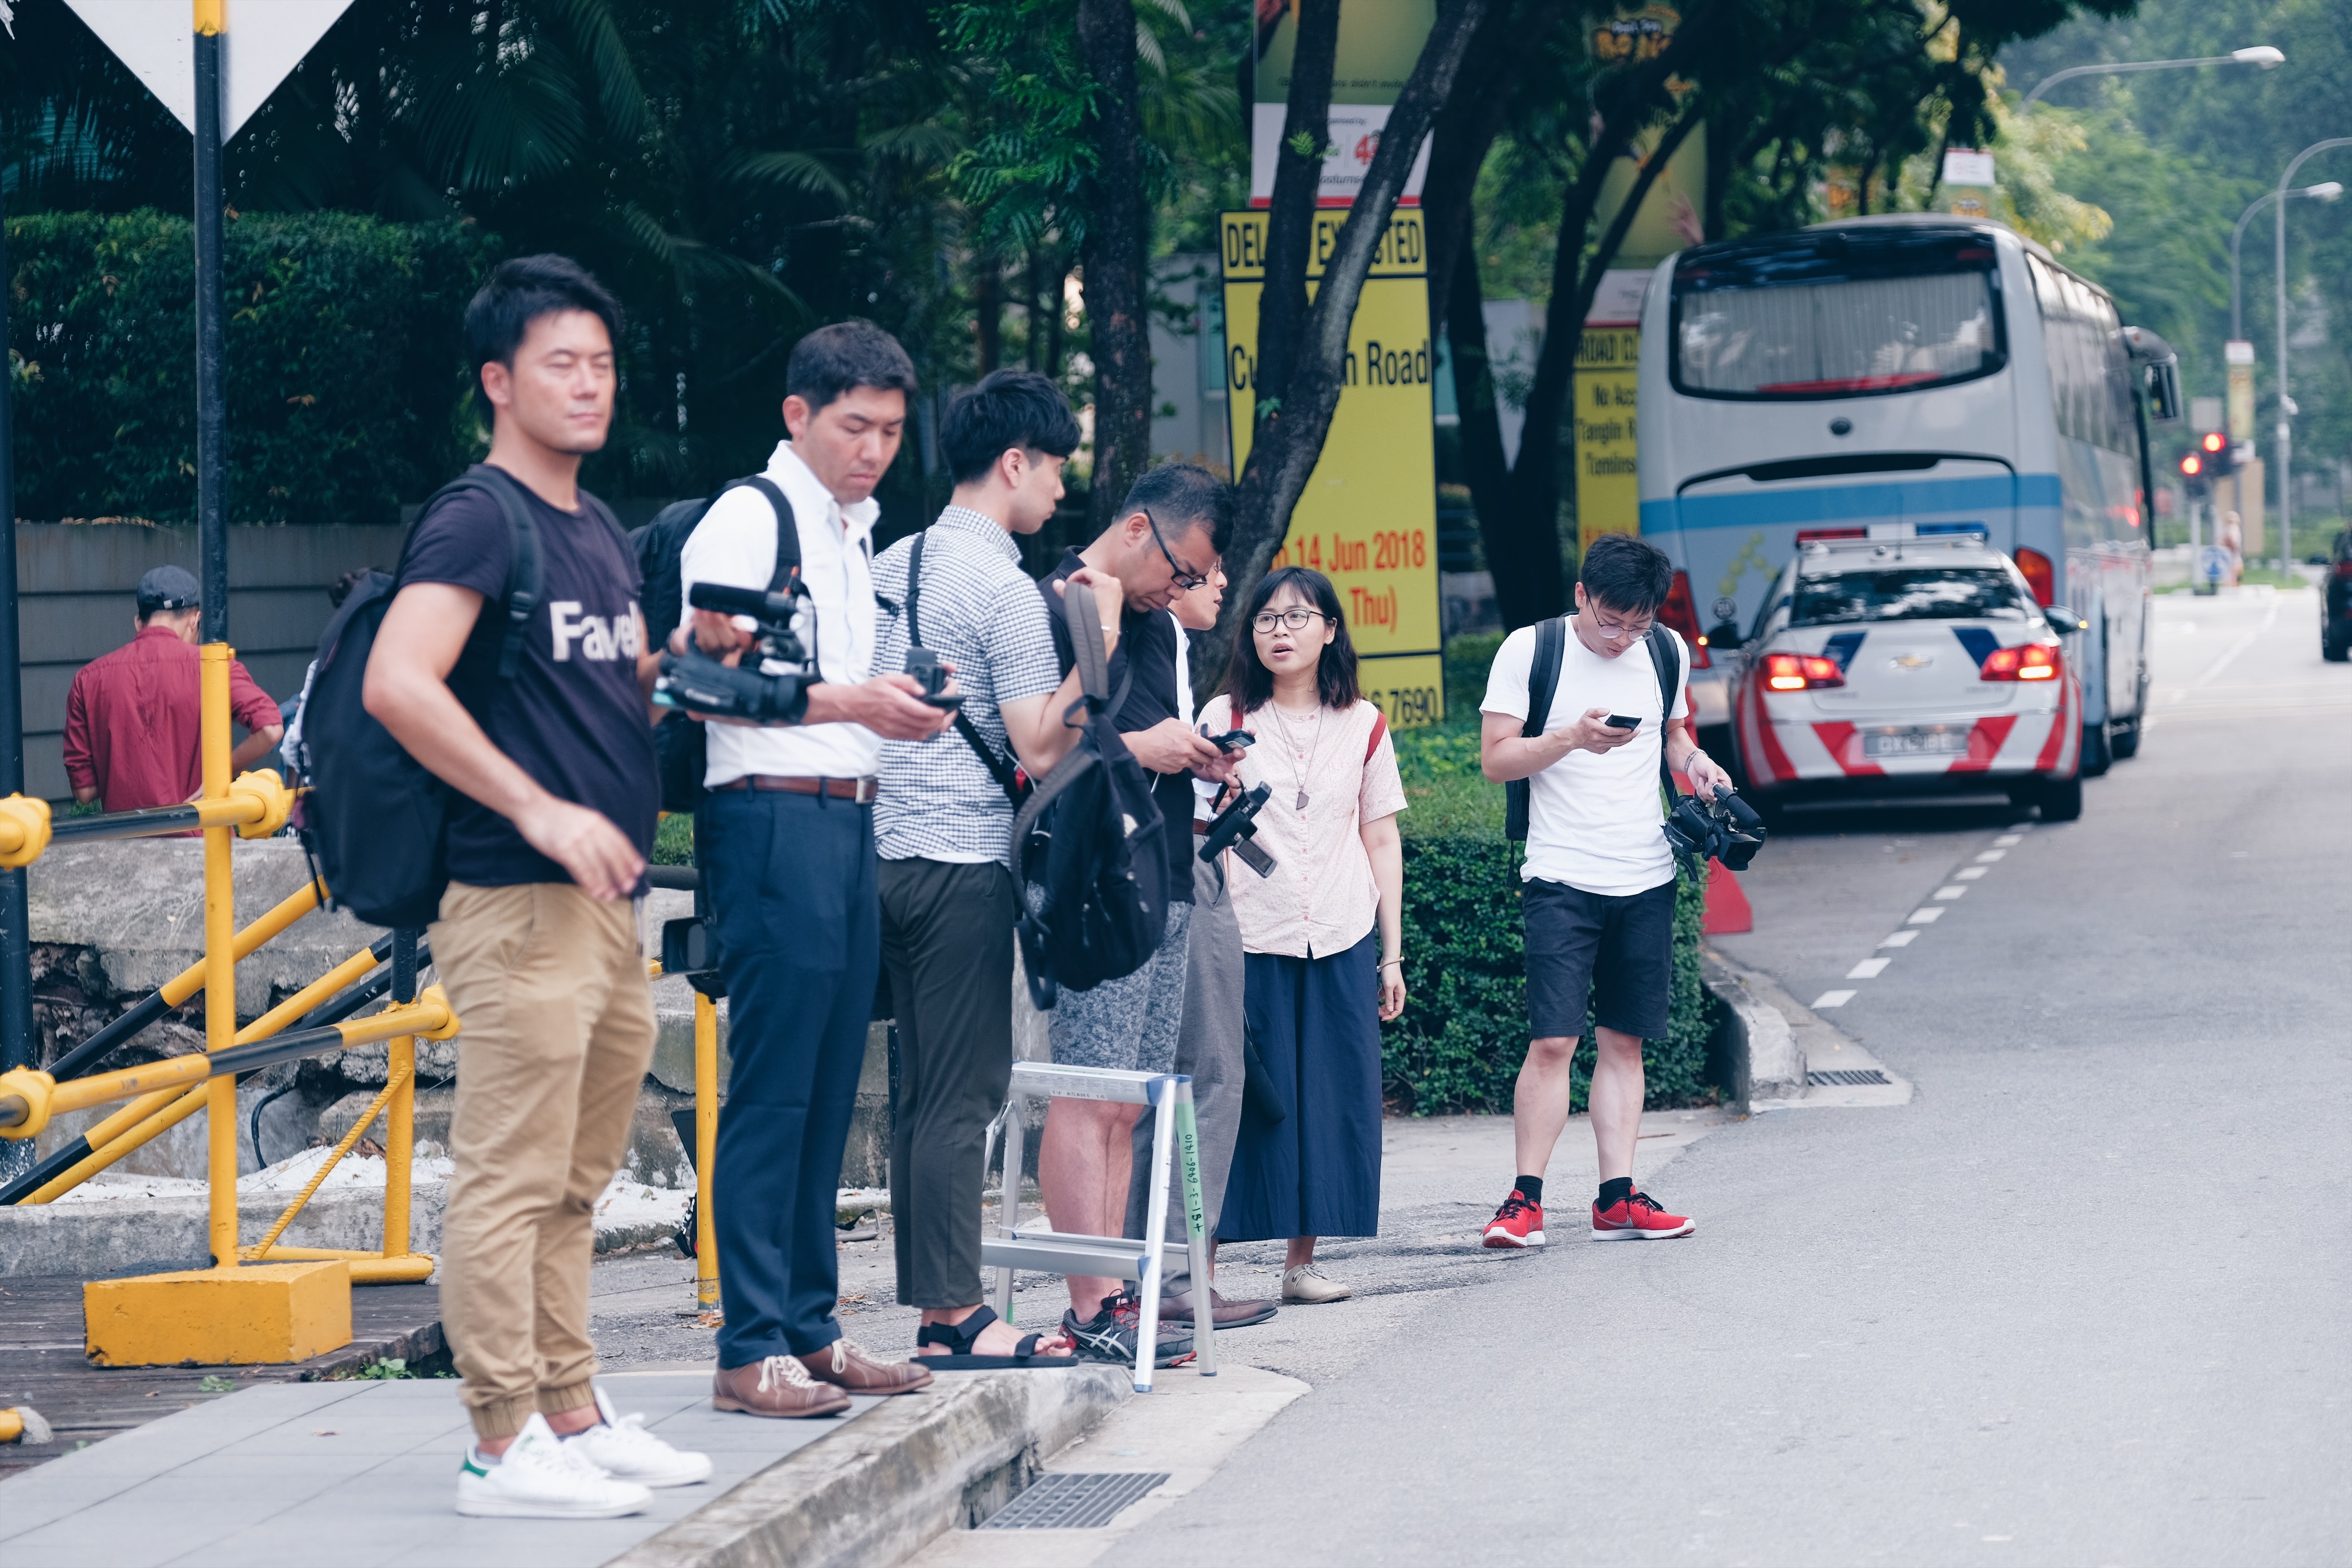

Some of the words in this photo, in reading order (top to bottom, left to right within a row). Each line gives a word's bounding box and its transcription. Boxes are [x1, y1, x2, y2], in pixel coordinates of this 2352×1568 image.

[1368, 340, 1430, 385] Road
[1294, 534, 1321, 570] 14
[1328, 531, 1367, 573] Jun
[1373, 528, 1427, 570] 2018
[1388, 686, 1437, 723] 7690
